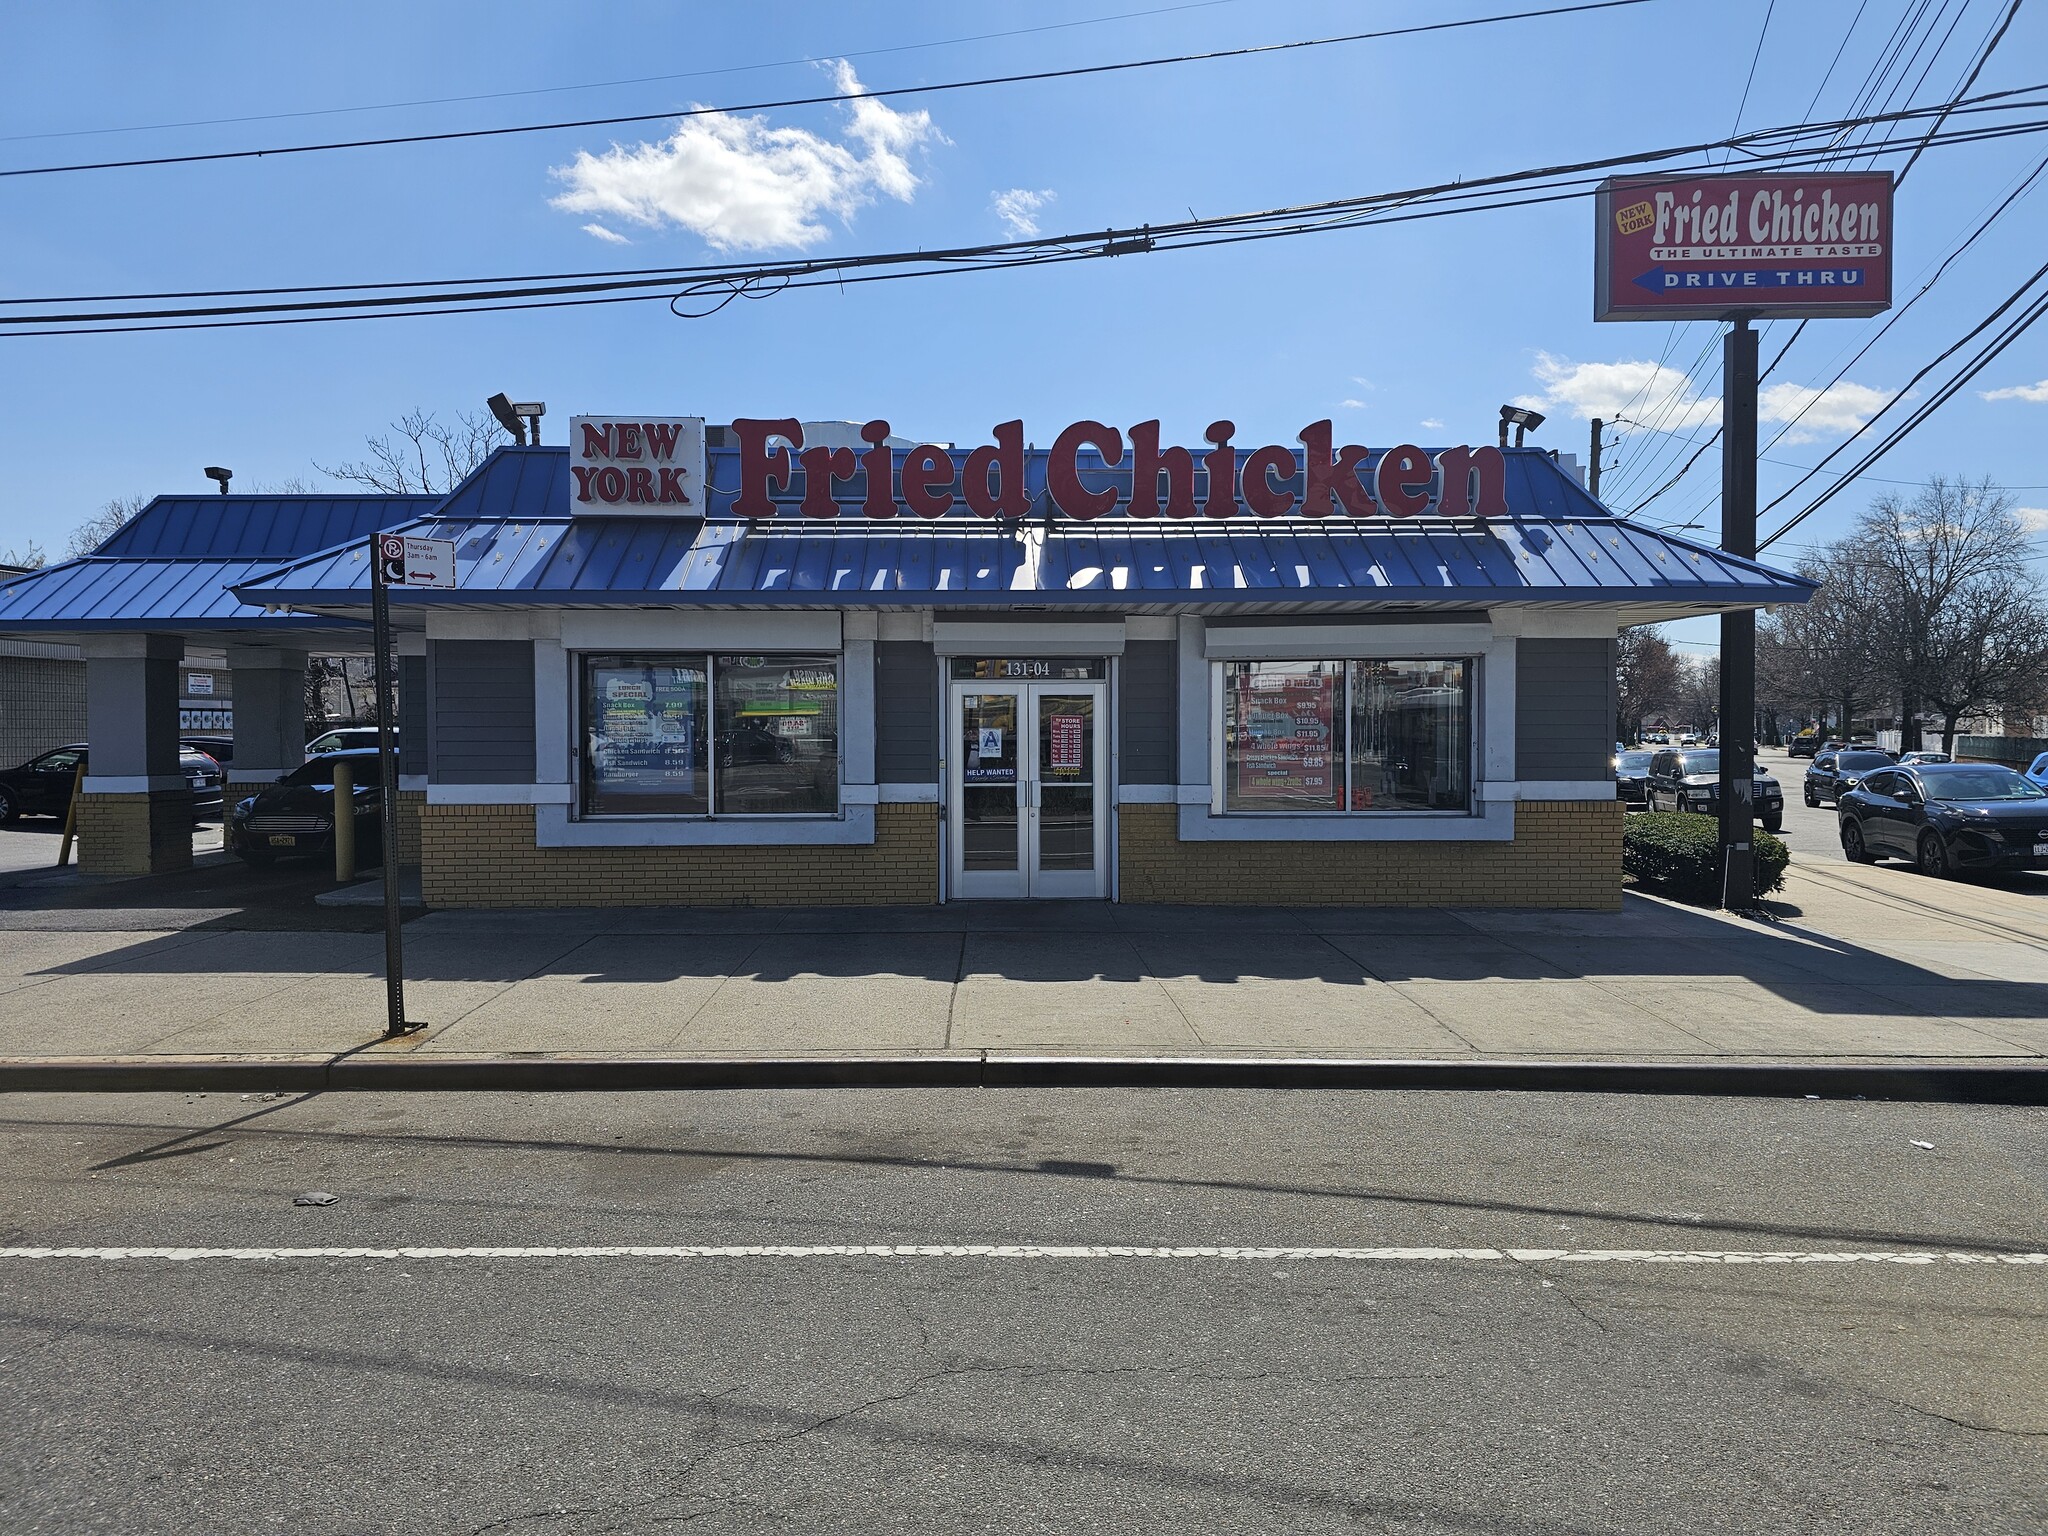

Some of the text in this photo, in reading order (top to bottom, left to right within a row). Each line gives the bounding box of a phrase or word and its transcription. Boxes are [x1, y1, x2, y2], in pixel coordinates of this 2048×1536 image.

[1620, 203, 1648, 222] NEW
[1653, 188, 1880, 245] Fried Chicken
[1621, 213, 1653, 234] YORK
[1654, 246, 1878, 259] THE ULTIMATE TASTE
[1664, 270, 1858, 287] DRIVE THRU
[581, 423, 685, 463] NEW
[730, 418, 1509, 521] Fried Chicken
[571, 466, 692, 505] YORK
[407, 543, 433, 552] Thursday
[1006, 662, 1050, 676] 131-04
[1294, 679, 1321, 687] MEAL
[984, 731, 999, 747] A
[1279, 743, 1300, 751] wings
[1303, 757, 1324, 767] $9.85
[1305, 777, 1323, 785] $7.95
